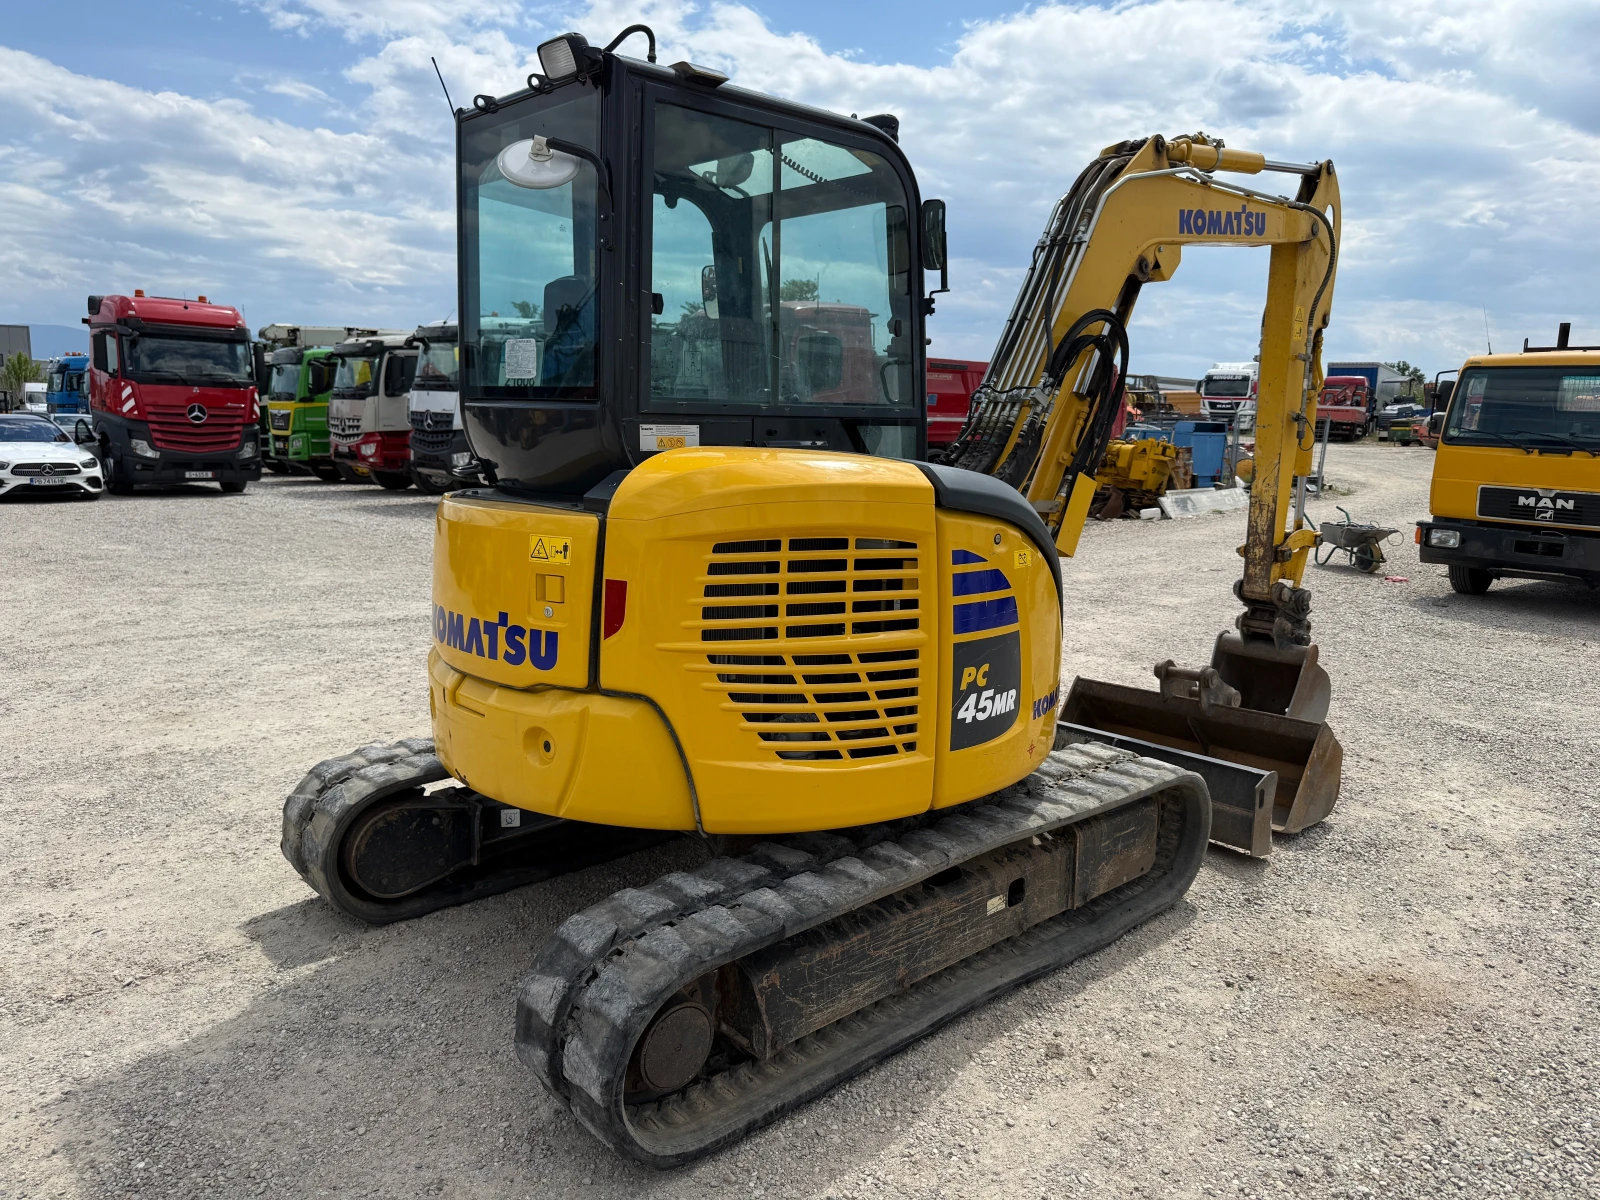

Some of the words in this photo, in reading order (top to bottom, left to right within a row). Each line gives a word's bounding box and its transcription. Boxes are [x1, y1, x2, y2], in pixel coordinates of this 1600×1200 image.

[1178, 204, 1266, 237] KOMATSU
[1518, 495, 1575, 510] MAN
[959, 663, 990, 691] PC
[956, 688, 1017, 724] 45MR
